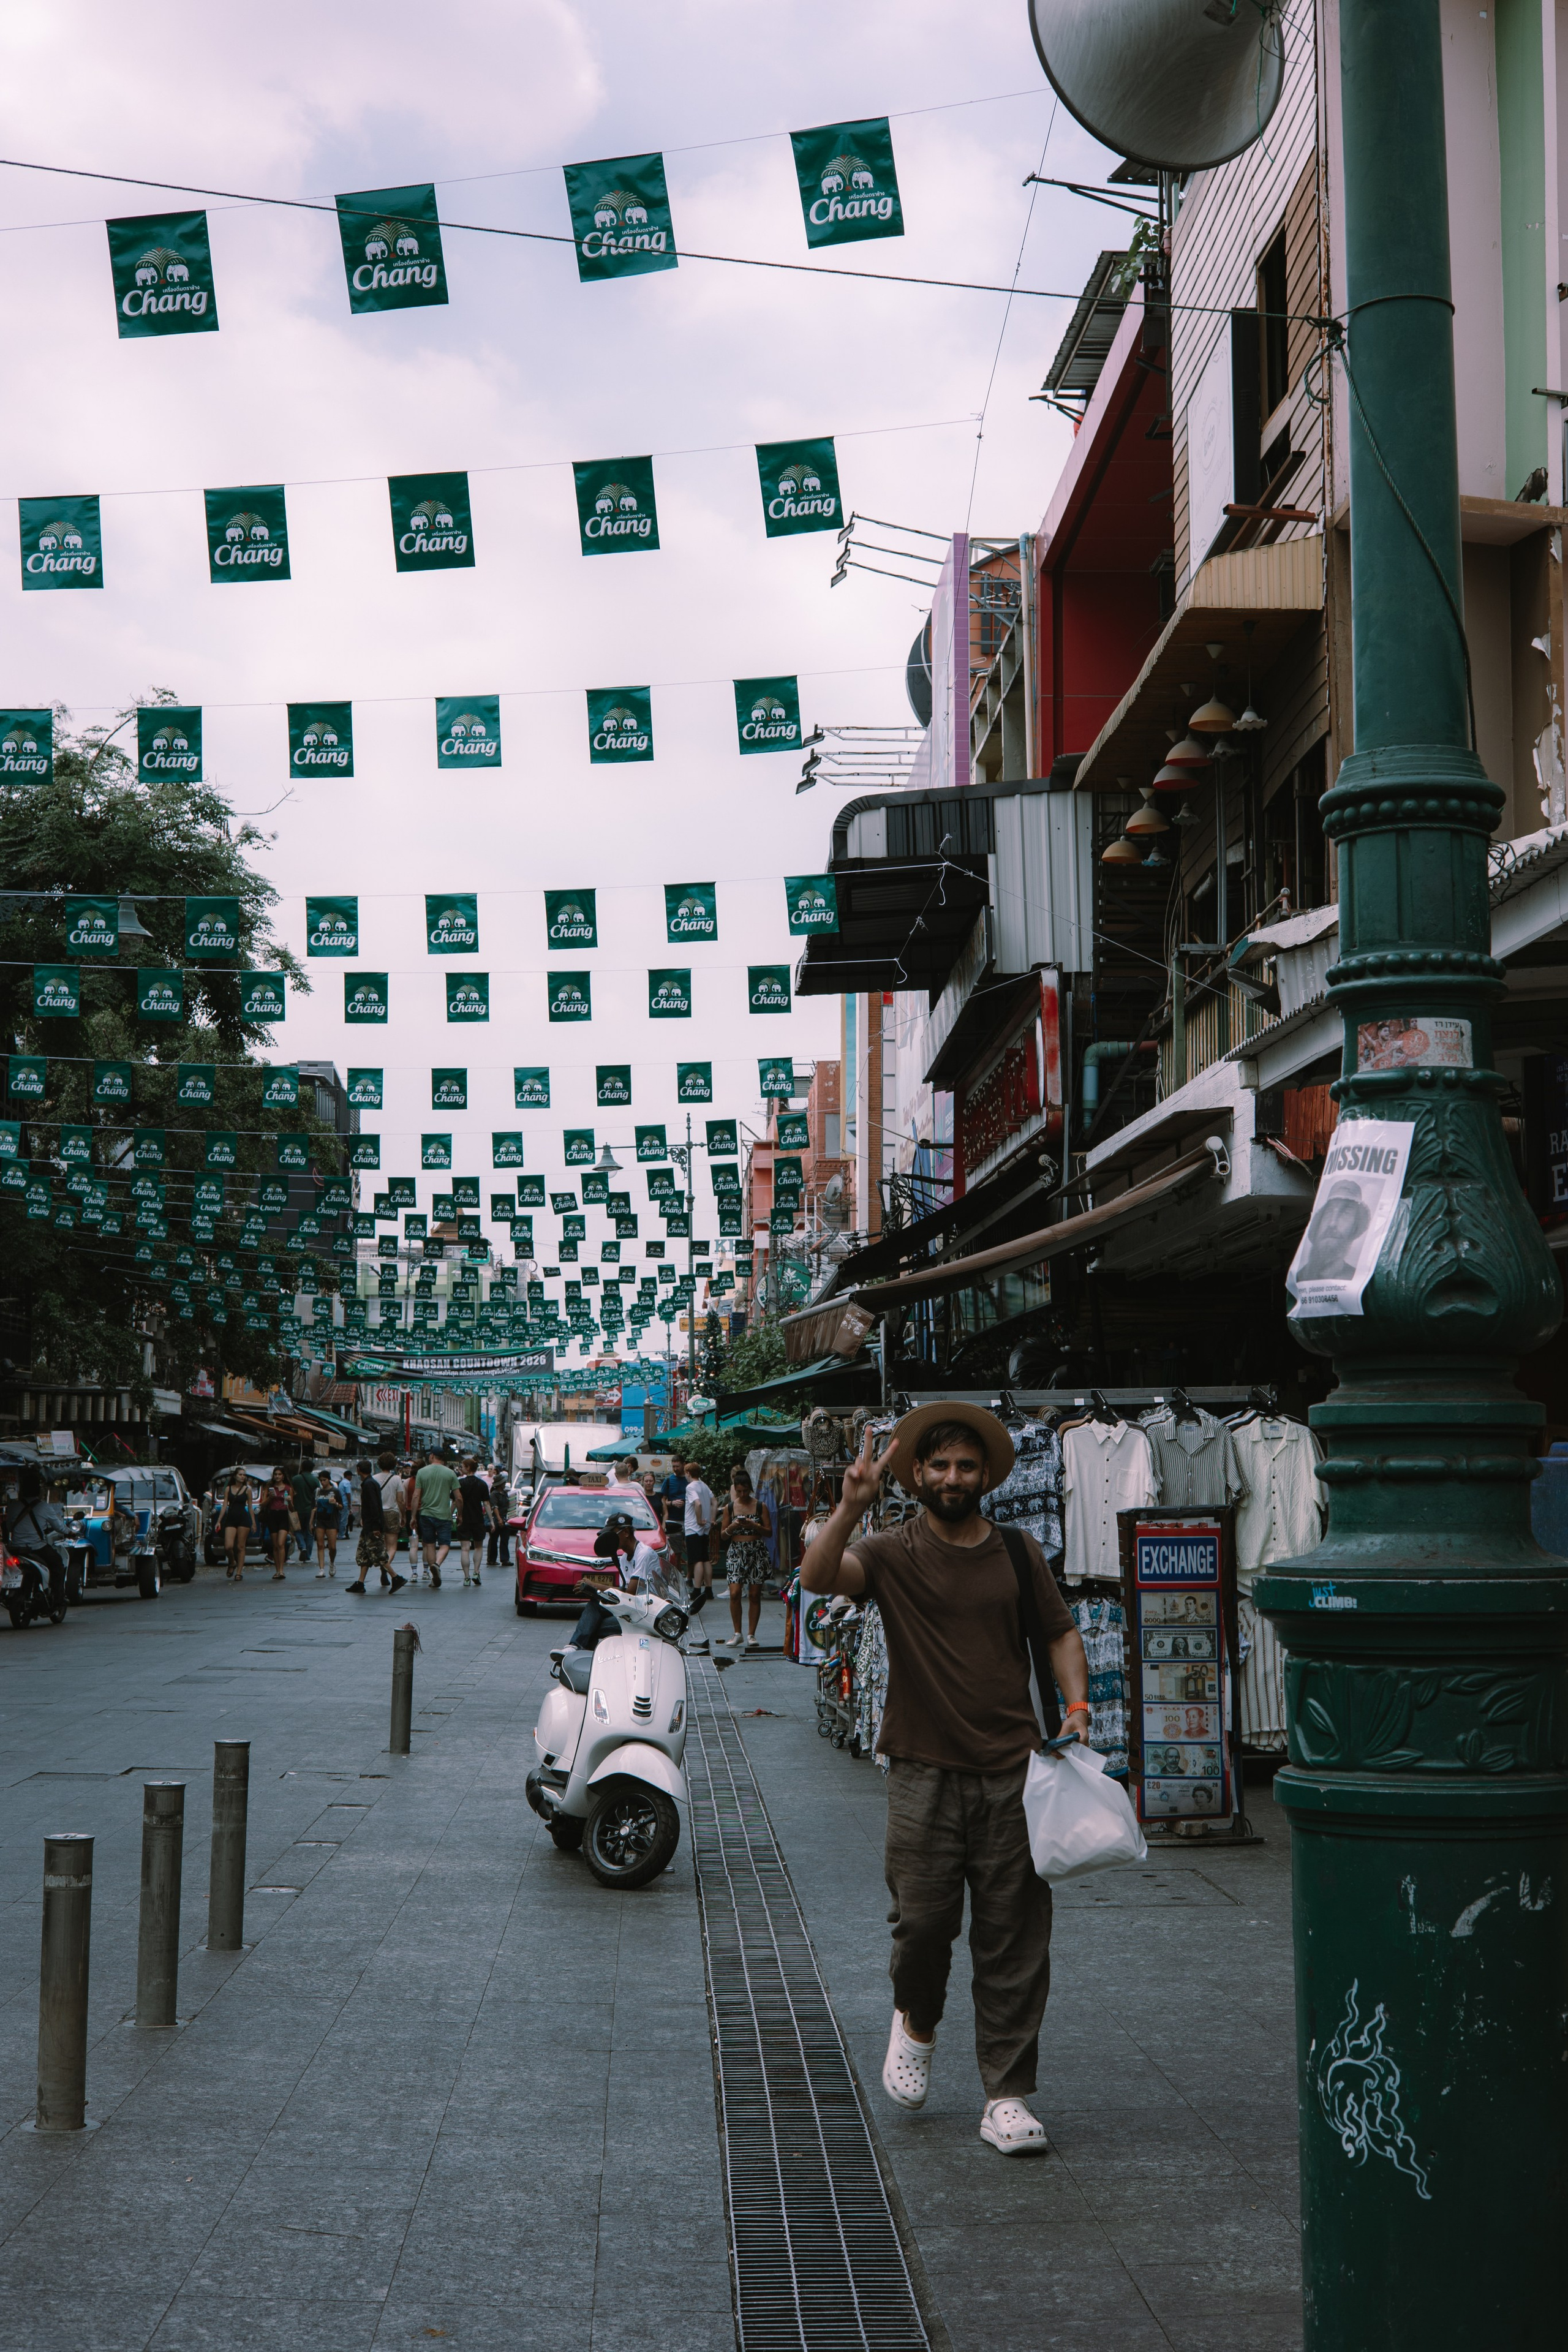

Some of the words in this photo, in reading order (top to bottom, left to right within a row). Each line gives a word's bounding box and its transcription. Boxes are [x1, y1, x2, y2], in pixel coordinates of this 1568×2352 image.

[809, 196, 892, 225] Chang
[582, 228, 667, 258] Chang
[353, 264, 437, 291] Chang
[123, 290, 208, 317] Chang
[769, 497, 835, 519] Chang
[585, 516, 651, 537] Chang
[399, 533, 467, 554] Chang
[214, 545, 283, 567] Chang
[26, 553, 96, 575] Chang
[742, 723, 797, 740] Chang
[441, 739, 497, 756] Chang
[594, 733, 648, 750] Chang
[143, 752, 198, 771] Chang
[293, 748, 349, 767] Chang
[791, 911, 834, 924] Chang
[670, 918, 714, 932] Chang
[70, 930, 115, 946] Chang
[431, 930, 475, 944] Chang
[551, 925, 593, 939] Chang
[189, 933, 235, 949] Chang
[311, 933, 356, 948] Chang
[37, 995, 76, 1009] Chang
[141, 999, 179, 1012] Chang
[652, 998, 688, 1010] Chang
[752, 994, 788, 1006] Chang
[245, 1001, 282, 1014] Chang
[348, 1003, 385, 1016] Chang
[450, 1002, 486, 1014] Chang
[551, 1001, 588, 1014] Chang
[12, 1081, 43, 1093] Chang
[97, 1085, 128, 1096] Chang
[680, 1087, 710, 1097] Chang
[763, 1081, 791, 1091] Chang
[180, 1088, 211, 1100] Chang
[266, 1091, 296, 1102] Chang
[349, 1093, 380, 1104] Chang
[434, 1093, 465, 1104] Chang
[517, 1092, 548, 1102] Chang
[598, 1090, 628, 1099] Chang
[62, 1147, 89, 1158] Chang
[136, 1150, 162, 1160] Chang
[638, 1147, 665, 1156] Chang
[208, 1153, 235, 1163] Chang
[280, 1155, 306, 1165] Chang
[353, 1155, 379, 1164] Chang
[423, 1155, 450, 1164] Chang
[1324, 1145, 1398, 1175] MISSING
[2, 1177, 26, 1186] Chang
[67, 1183, 91, 1192] Chang
[132, 1187, 156, 1197] Chang
[196, 1191, 220, 1200] Chang
[262, 1193, 287, 1202] Chang
[326, 1195, 350, 1204] Chang
[454, 1195, 478, 1204] Chang
[661, 1206, 682, 1215] Chang
[1308, 1286, 1324, 1294] please
[357, 1362, 384, 1371] Chang
[402, 1359, 450, 1369] KHAOSAN
[453, 1357, 518, 1368] COUNTDOWN
[520, 1355, 546, 1366] 2026
[388, 1389, 399, 1401] EXI
[1141, 1545, 1215, 1575] EXCHANGE
[1309, 1580, 1336, 1608] just
[1314, 1596, 1357, 1609] CLIMB!
[1191, 1665, 1208, 1678] 50
[1202, 1765, 1219, 1776] 100
[1147, 1781, 1161, 1790] £20
